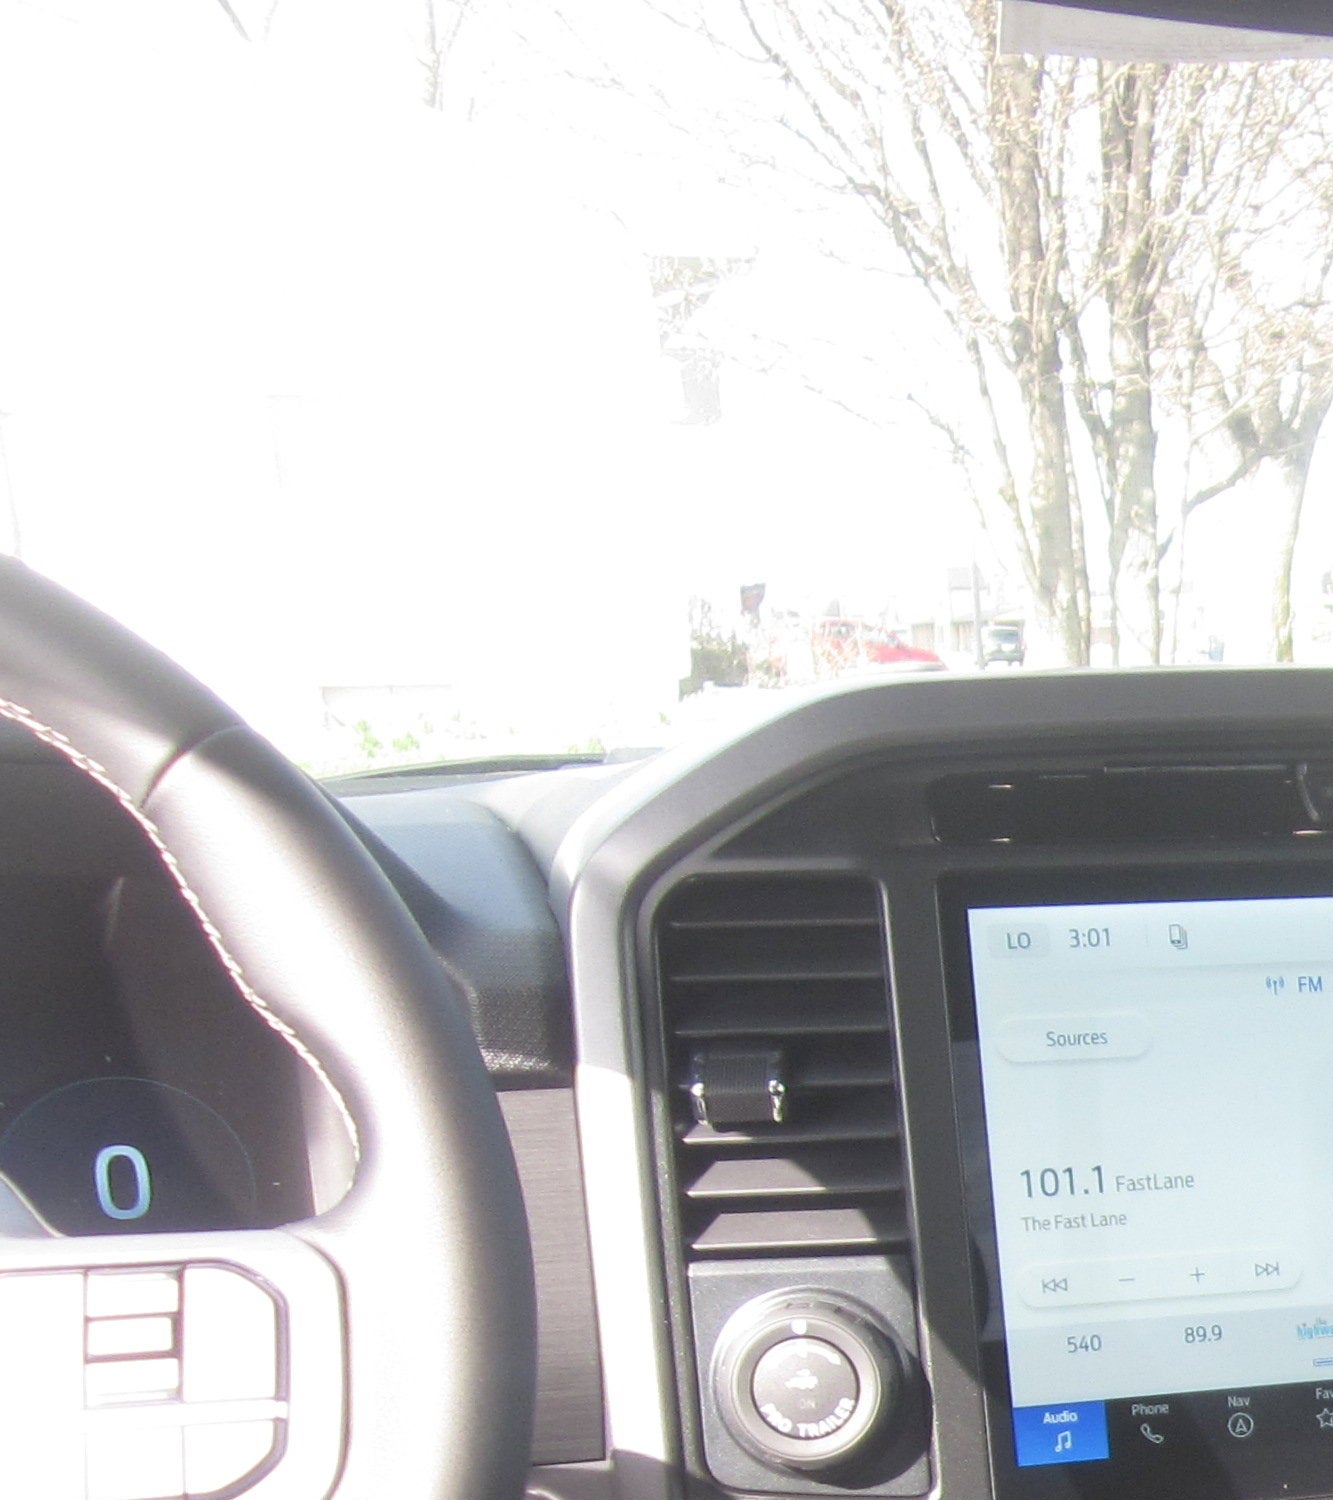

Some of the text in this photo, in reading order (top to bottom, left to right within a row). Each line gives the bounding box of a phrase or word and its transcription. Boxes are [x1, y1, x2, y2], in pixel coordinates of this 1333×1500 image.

[1006, 932, 1031, 950] LO
[1068, 927, 1112, 949] 3:01
[1297, 976, 1323, 993] FM
[1046, 1030, 1108, 1048] Sources
[94, 1144, 151, 1220] 0
[1020, 1165, 1195, 1199] 101.1 FastLane
[1022, 1211, 1127, 1232] The Fast Lane
[1184, 1325, 1222, 1345] 89.9
[1067, 1335, 1102, 1355] 540
[1131, 1402, 1169, 1416] Phone
[1228, 1395, 1250, 1408] Nav
[1043, 1410, 1078, 1424] Audio
